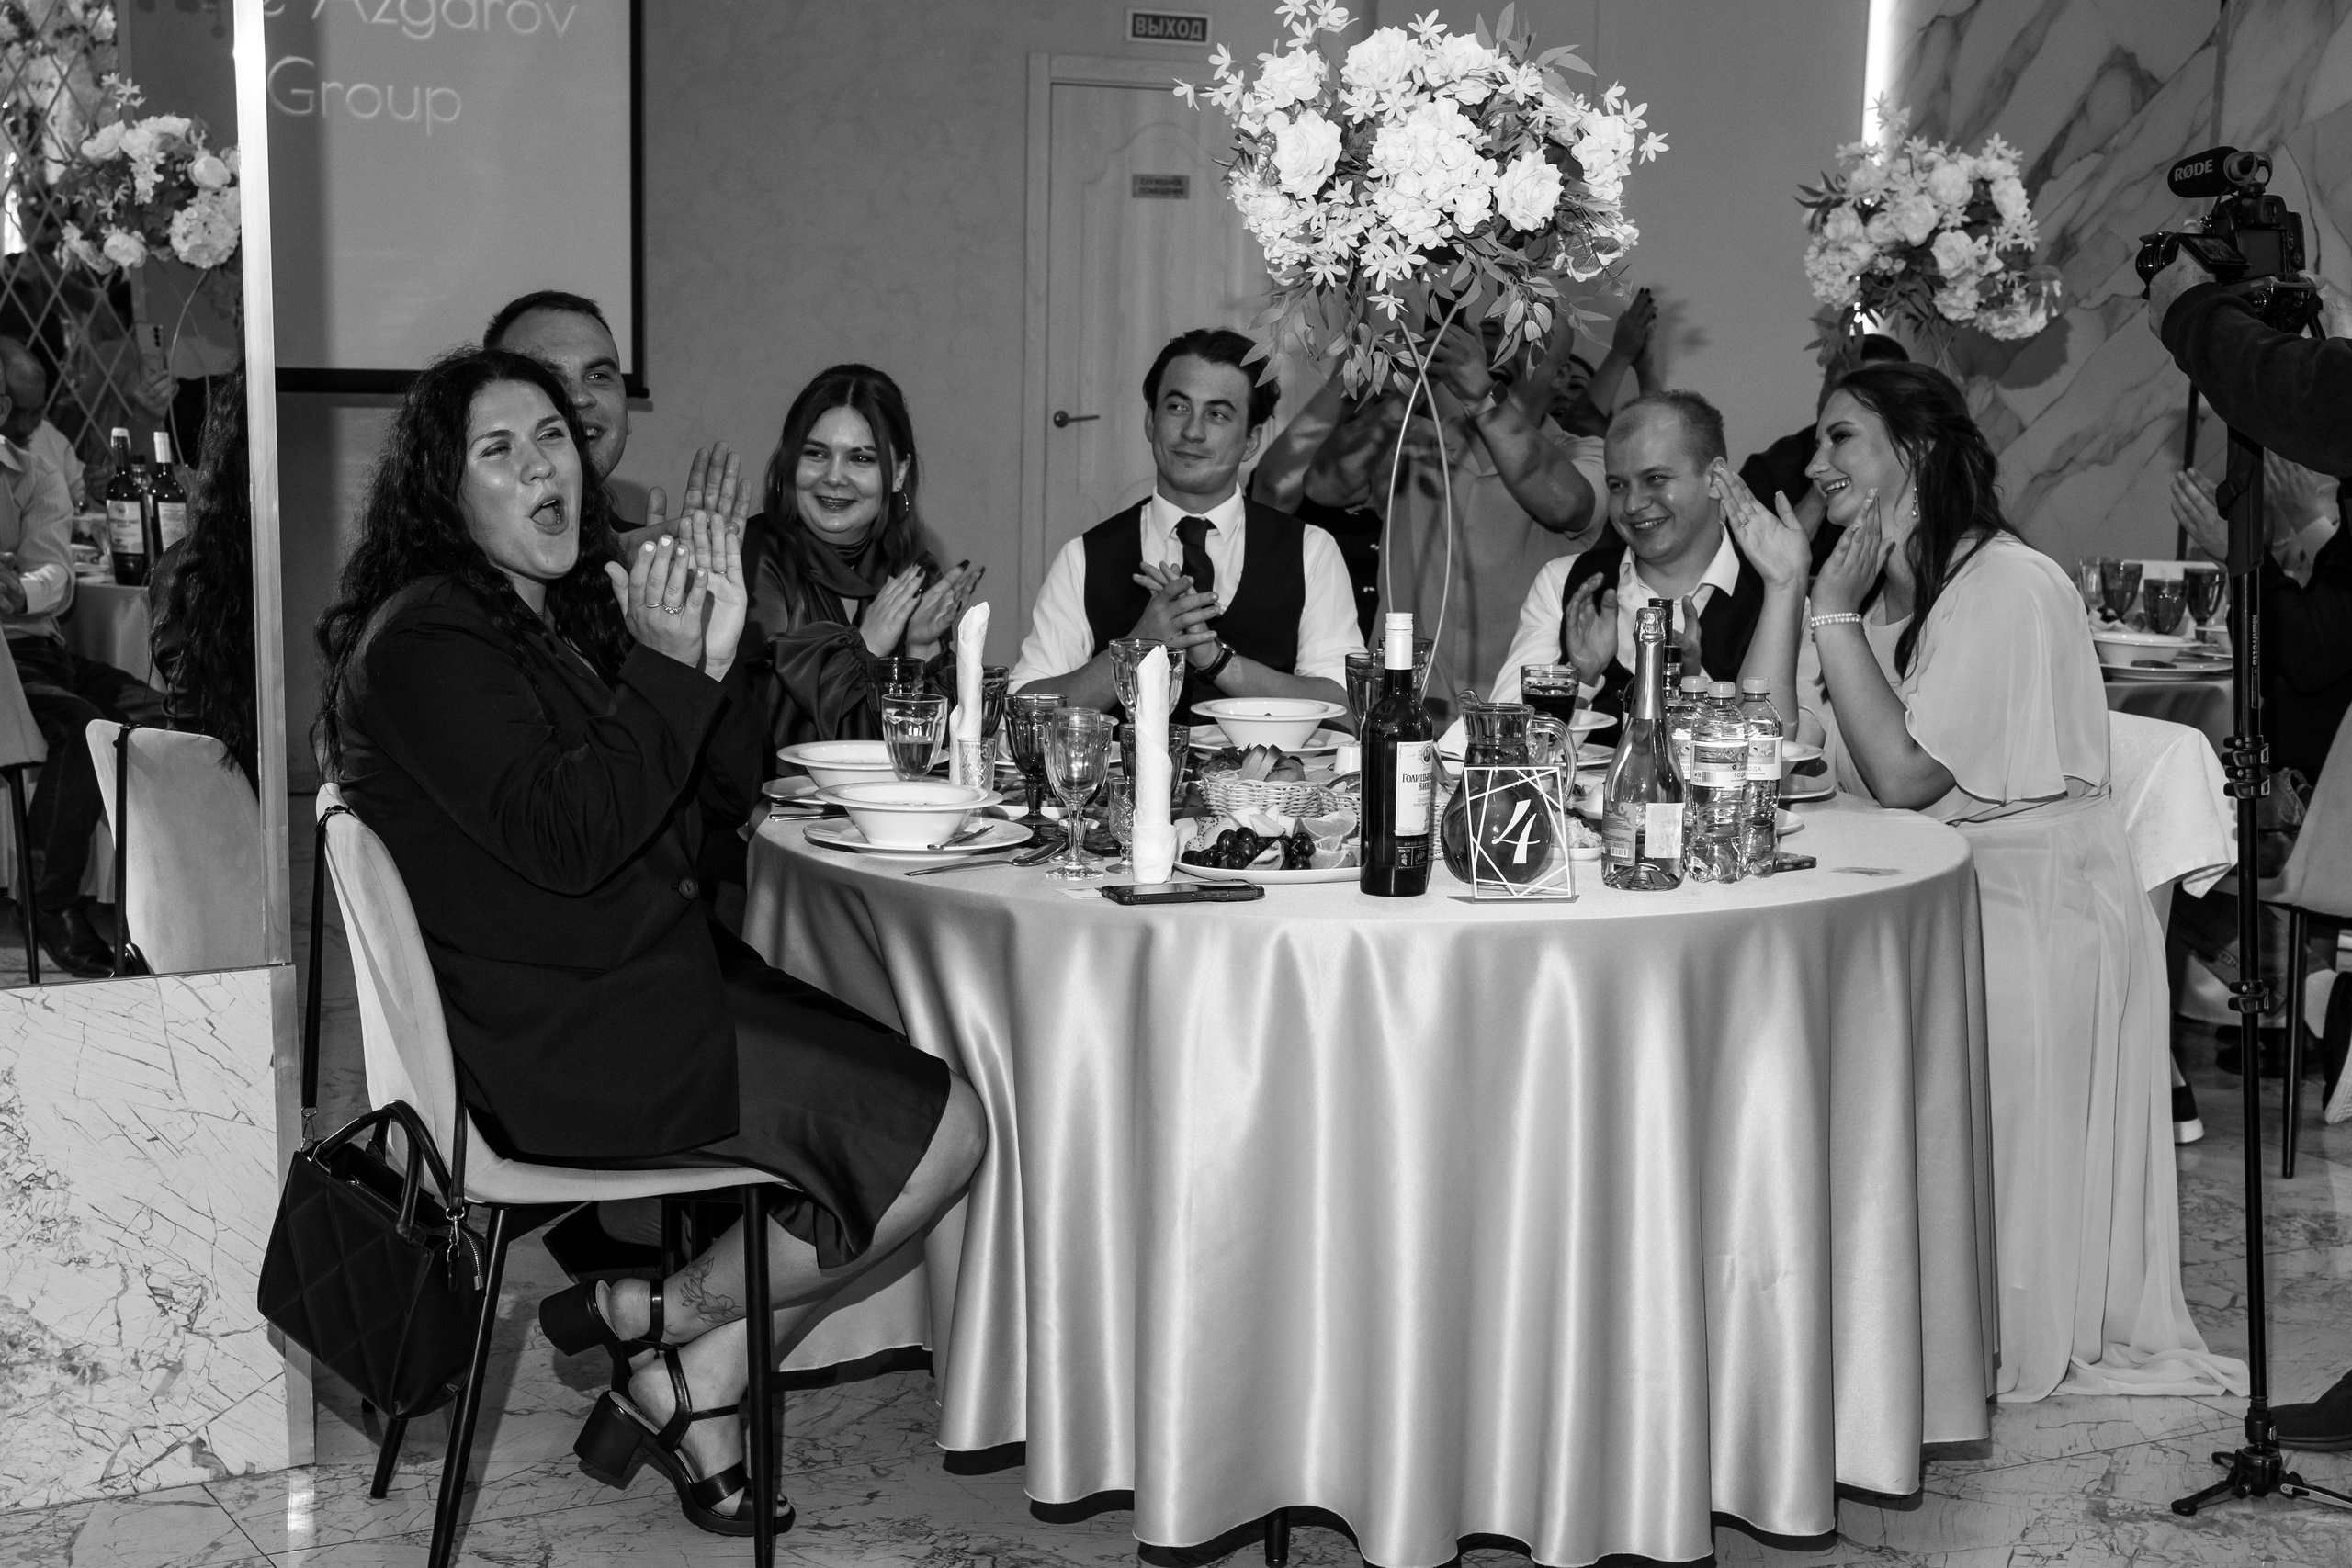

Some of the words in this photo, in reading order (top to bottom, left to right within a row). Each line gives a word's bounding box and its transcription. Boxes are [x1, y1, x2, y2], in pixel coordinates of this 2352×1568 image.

[1135, 17, 1204, 39] ВЫХОД
[267, 56, 460, 136] Group
[2174, 159, 2213, 182] RØDE
[1491, 799, 1541, 864] 4
